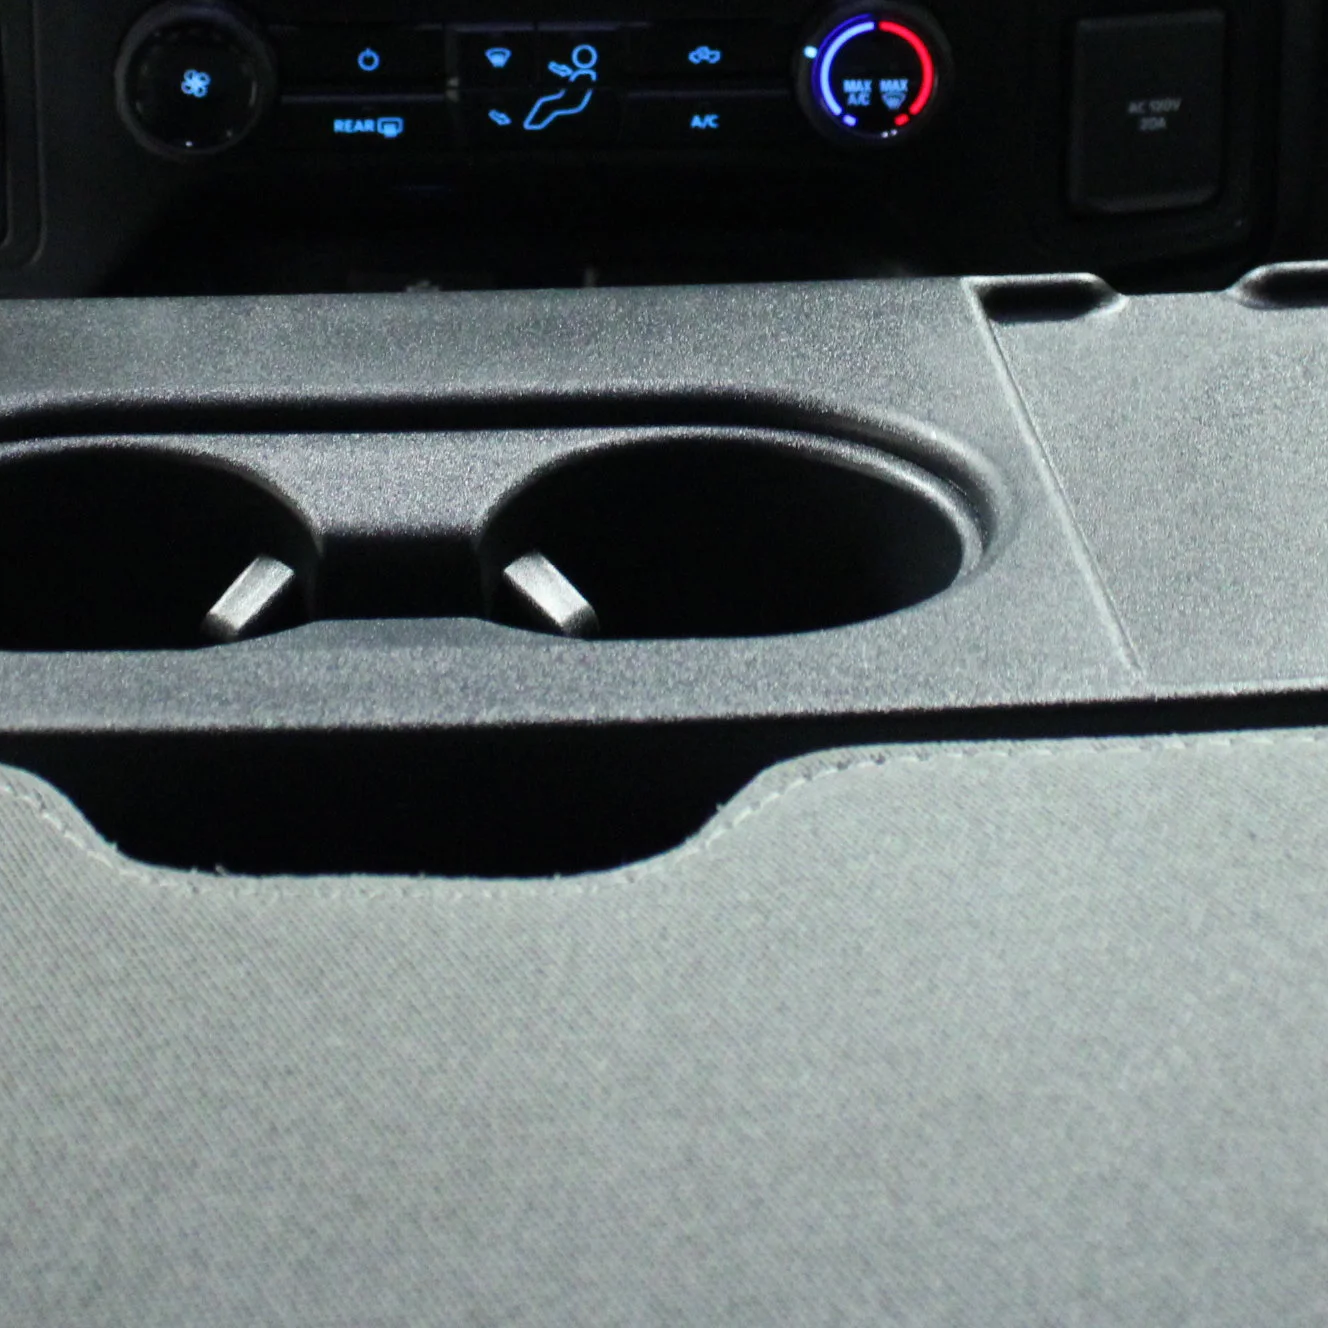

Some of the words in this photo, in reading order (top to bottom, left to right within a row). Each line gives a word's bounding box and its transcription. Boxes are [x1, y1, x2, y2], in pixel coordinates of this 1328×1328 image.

[842, 78, 872, 93] MAX
[879, 78, 908, 93] MAX
[847, 93, 872, 106] A/C
[333, 118, 375, 133] REAR
[691, 114, 720, 129] A/C
